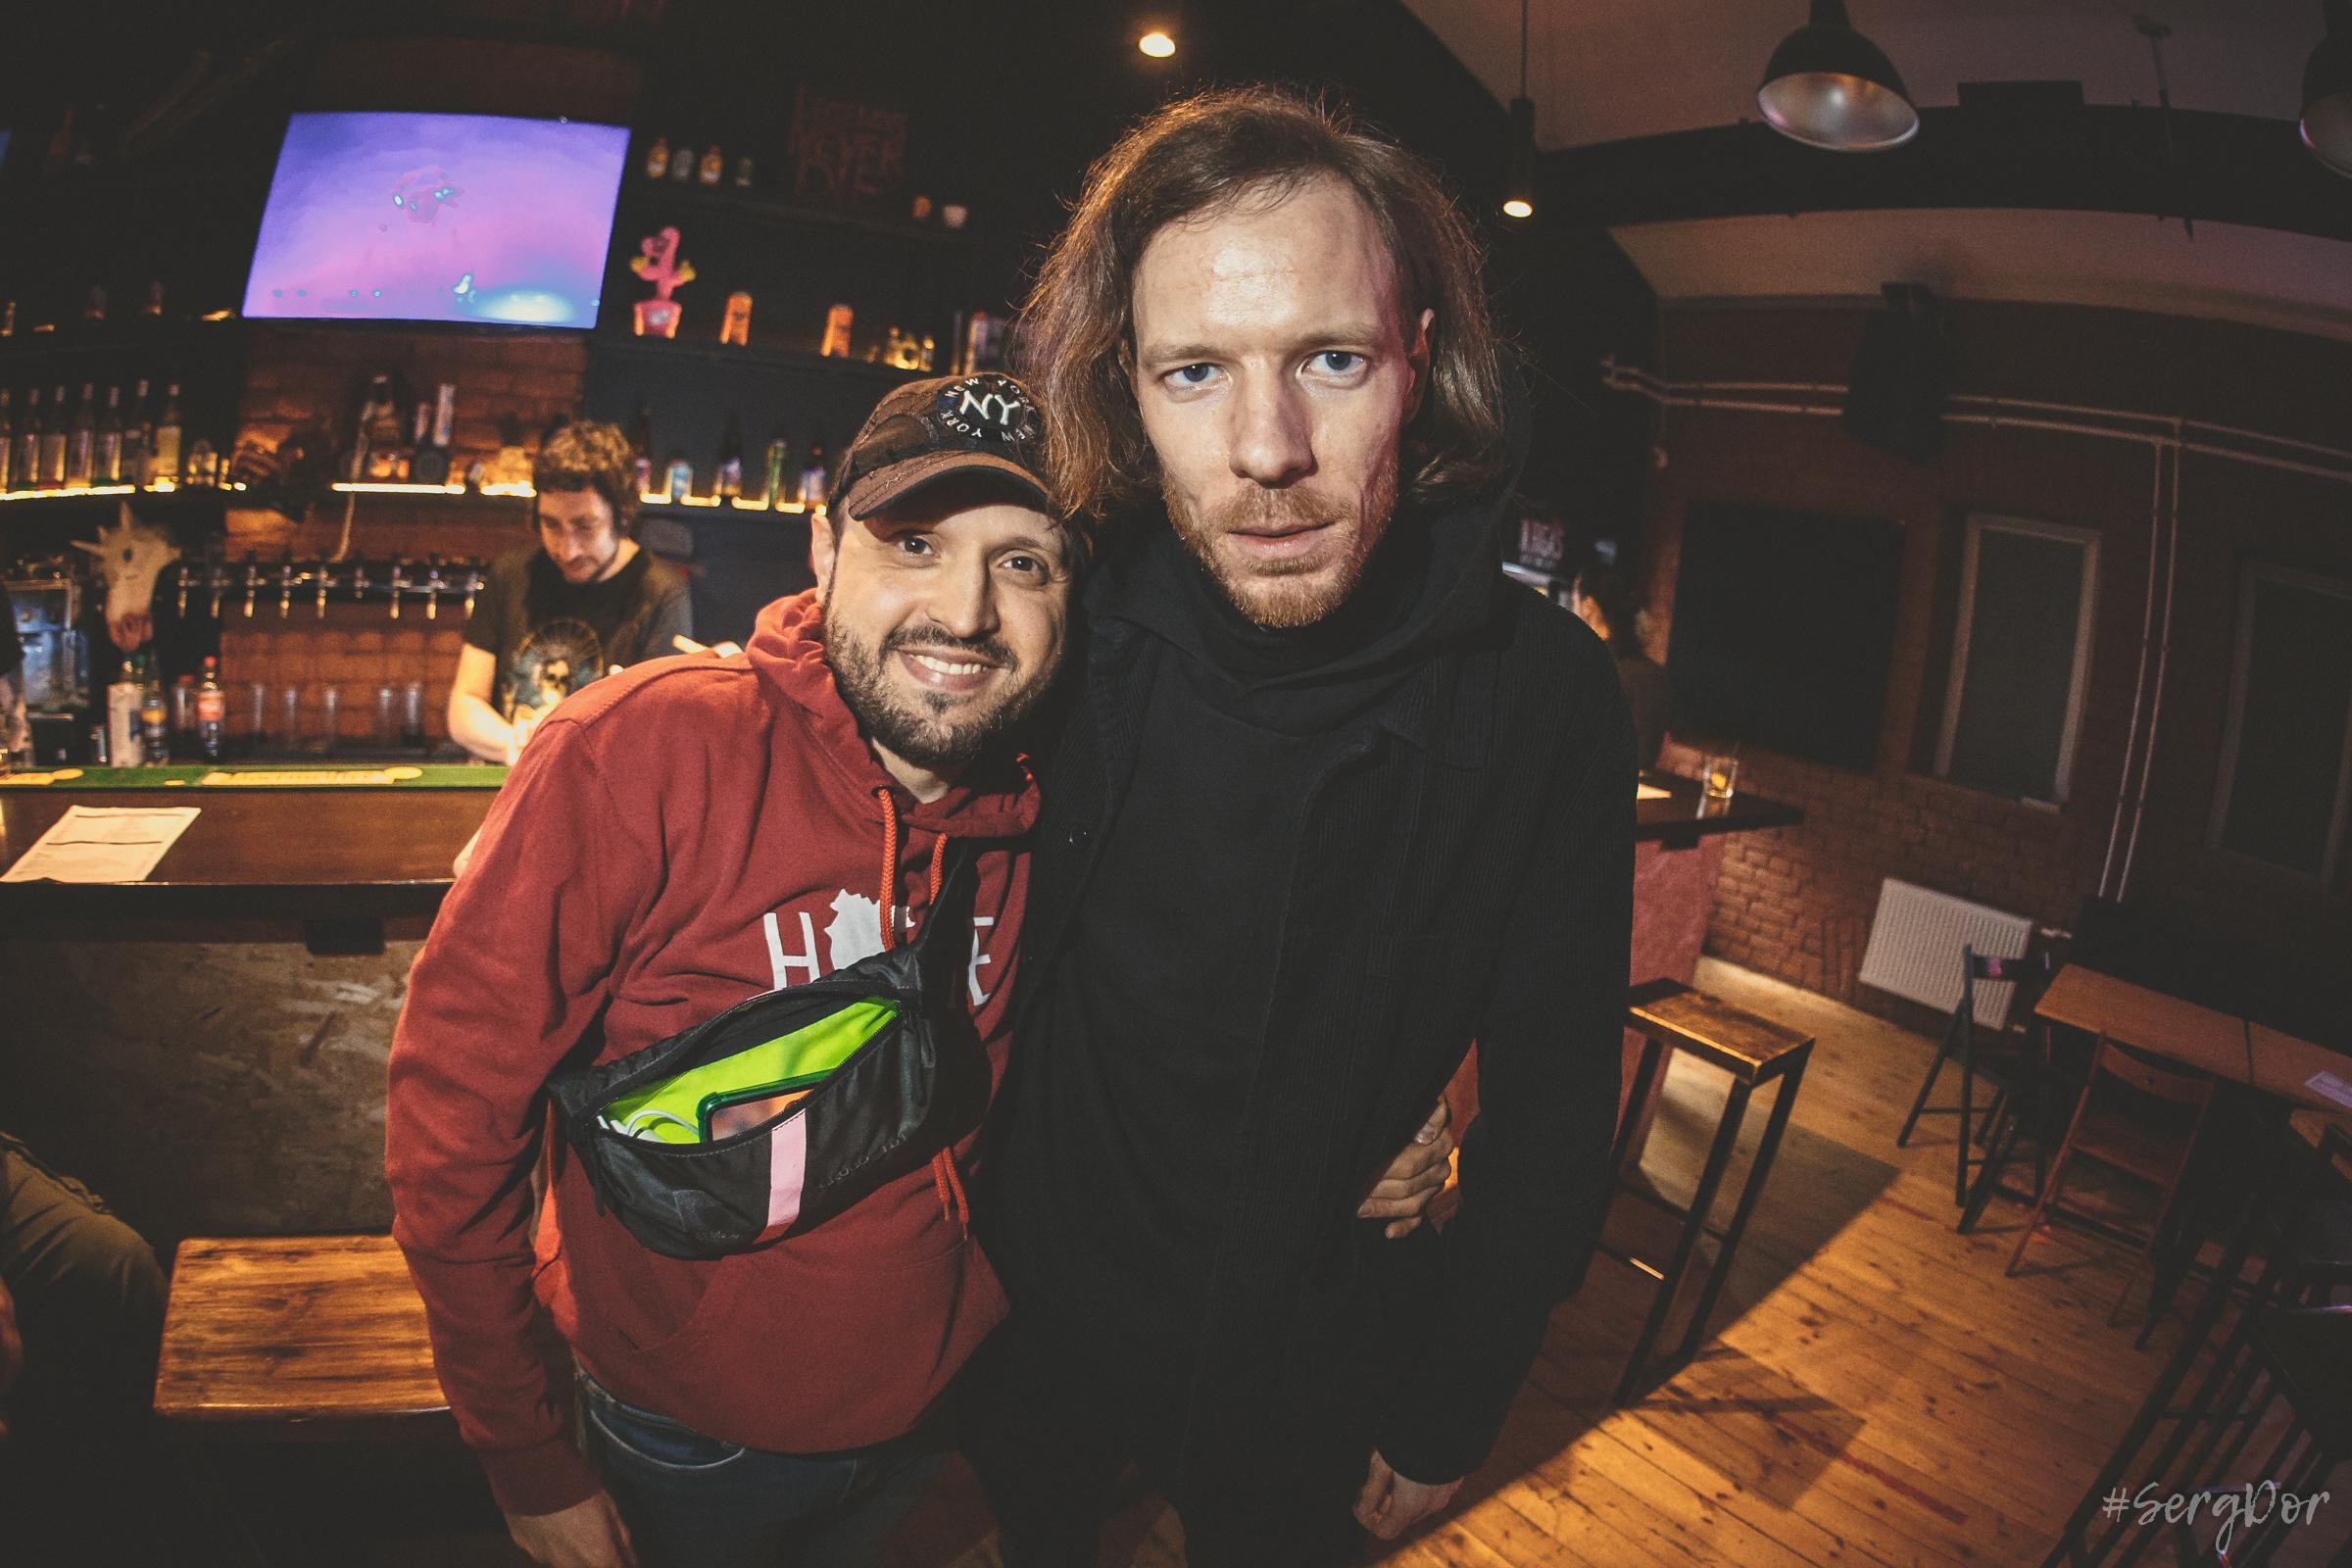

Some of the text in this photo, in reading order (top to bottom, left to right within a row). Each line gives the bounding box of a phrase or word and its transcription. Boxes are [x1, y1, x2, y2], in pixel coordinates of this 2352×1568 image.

[944, 377, 1036, 413] NEW YORK
[959, 390, 1021, 425] NY
[940, 410, 1036, 442] NEW YORK
